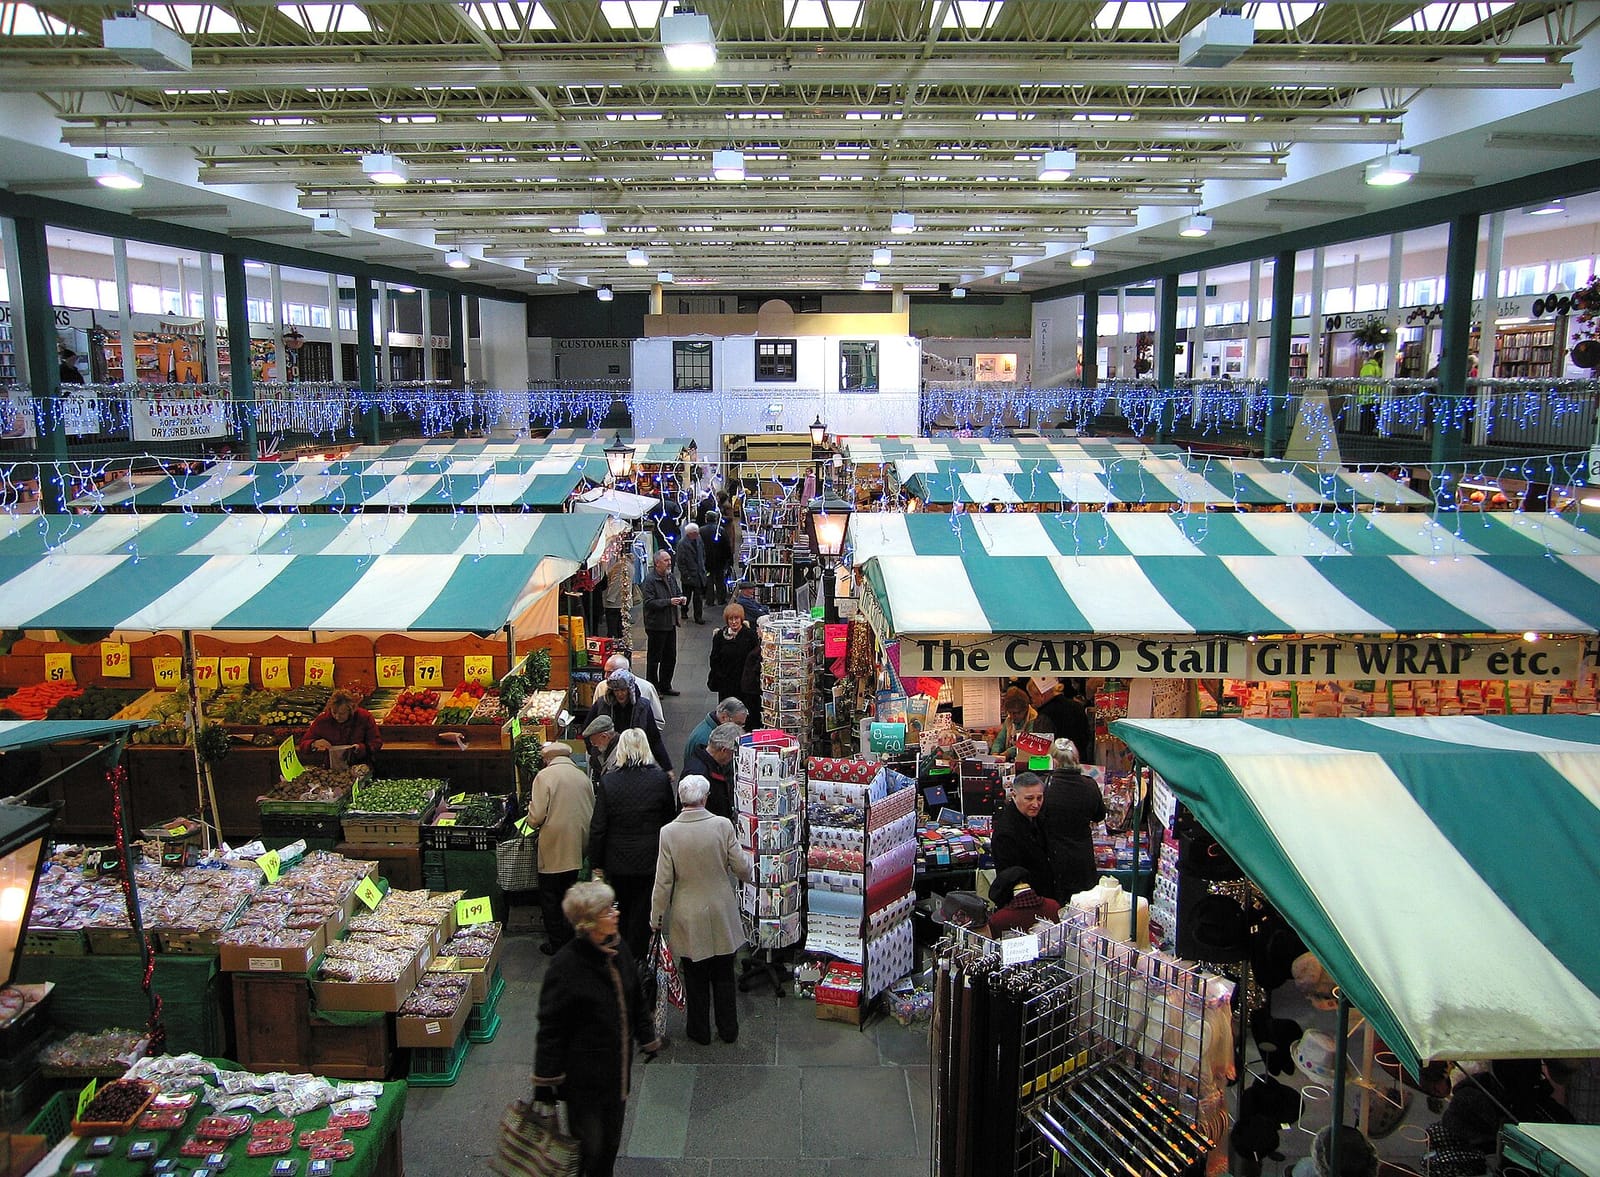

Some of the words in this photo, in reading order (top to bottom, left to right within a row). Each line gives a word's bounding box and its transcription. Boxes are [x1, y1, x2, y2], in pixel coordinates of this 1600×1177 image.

[1344, 315, 1367, 329] Rare
[560, 339, 618, 349] CUSTOMER
[151, 427, 167, 437] DRY
[105, 652, 121, 667] 89
[917, 639, 990, 672] The
[1004, 639, 1121, 673] CARD
[1136, 640, 1229, 673] Stall
[1256, 643, 1342, 676] GIFT
[1354, 642, 1473, 675] WRAP
[1486, 646, 1561, 676] etc.
[51, 667, 64, 681] 59
[159, 669, 173, 680] 99
[195, 666, 213, 680] 79
[224, 666, 241, 680] 79
[265, 666, 279, 680] 69
[383, 664, 398, 679] 59
[418, 666, 435, 680] 79
[873, 728, 882, 740] 8
[465, 904, 483, 919] 199
